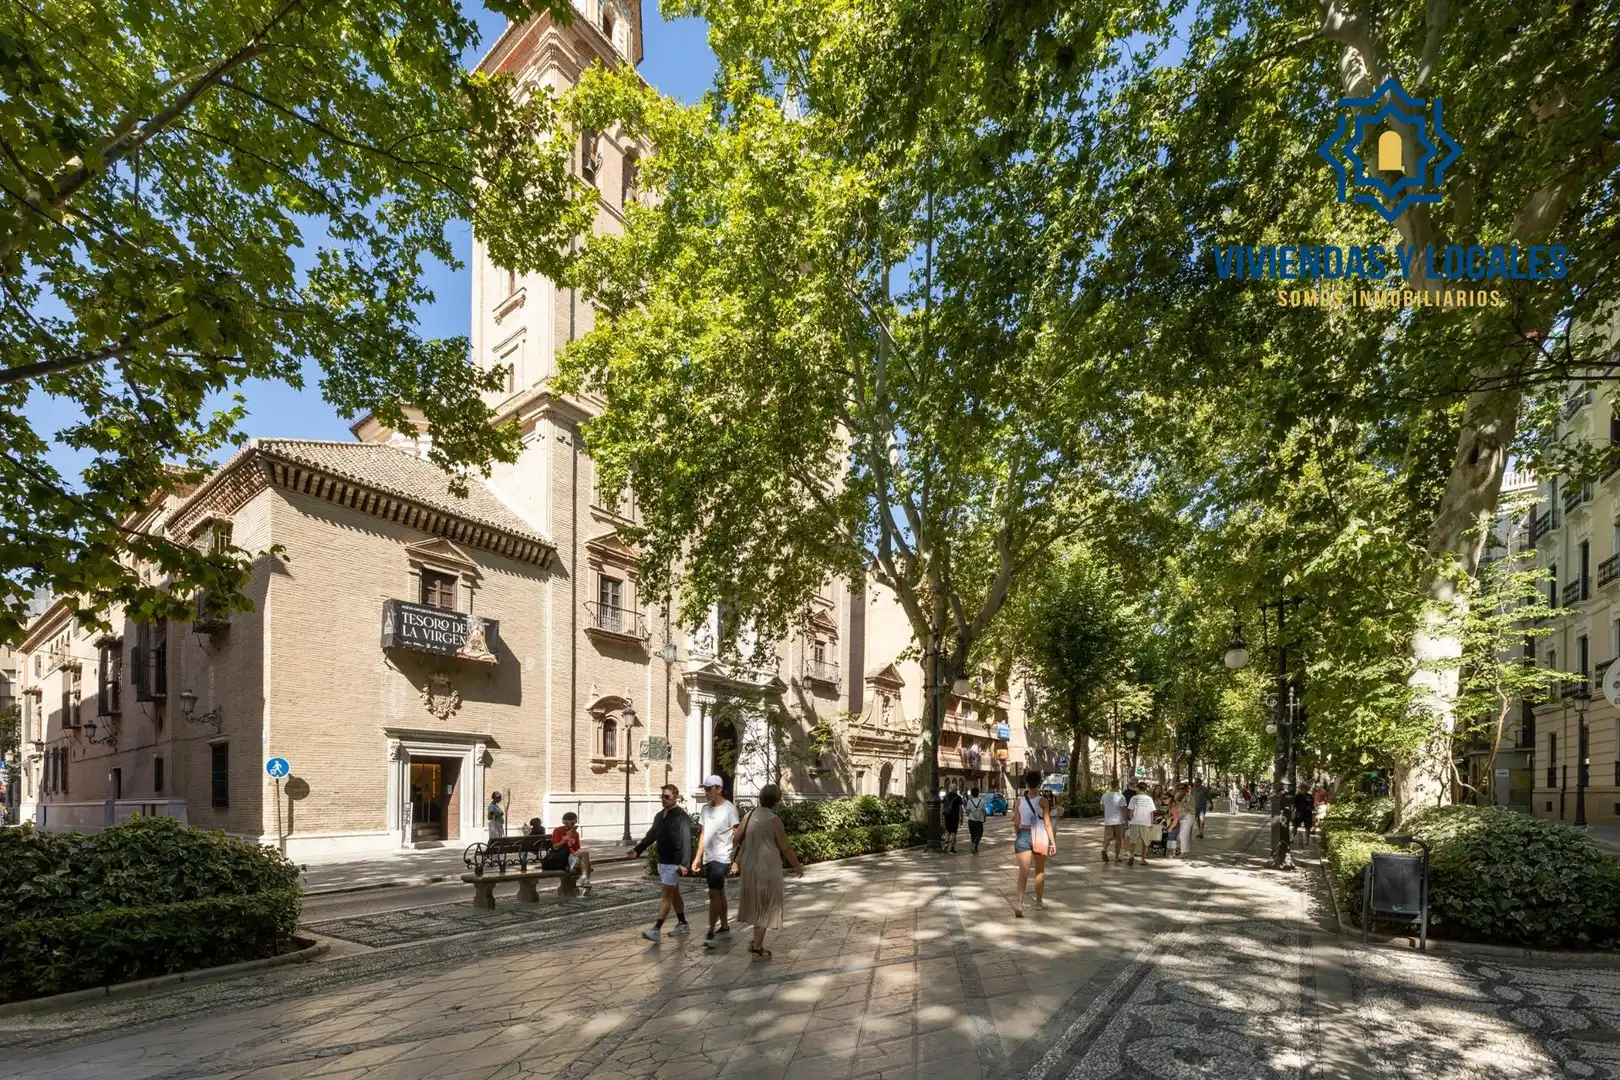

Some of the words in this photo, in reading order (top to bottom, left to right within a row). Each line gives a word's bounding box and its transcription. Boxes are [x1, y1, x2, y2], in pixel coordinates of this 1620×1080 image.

[401, 612, 450, 631] TESORO
[452, 621, 467, 634] DE
[402, 625, 417, 638] LA
[422, 628, 467, 646] VIRGEN
